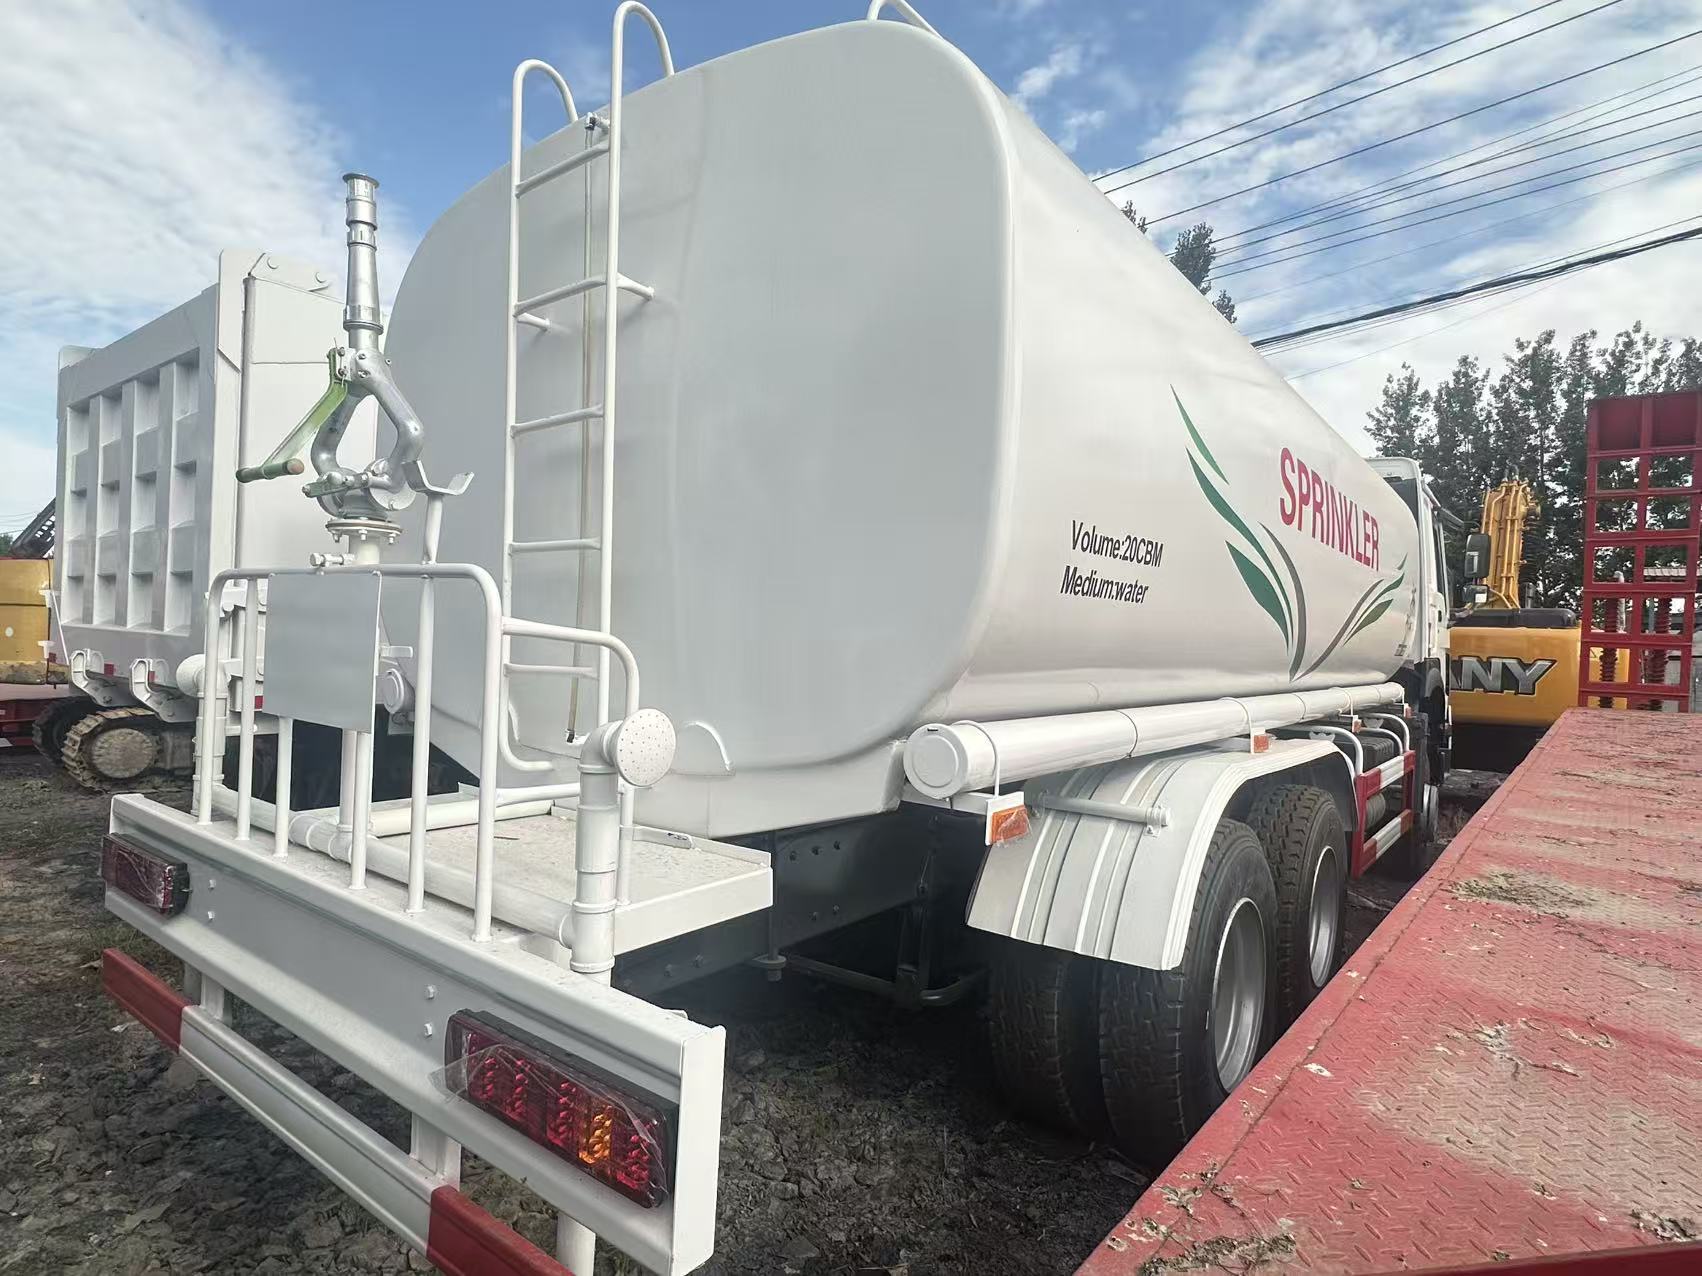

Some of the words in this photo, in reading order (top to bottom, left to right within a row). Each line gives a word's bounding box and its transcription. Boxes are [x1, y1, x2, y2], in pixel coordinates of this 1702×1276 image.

[1280, 447, 1379, 571] SPRINKLER
[1072, 520, 1164, 567] Volume:20CBM
[1060, 565, 1149, 603] Medium:water
